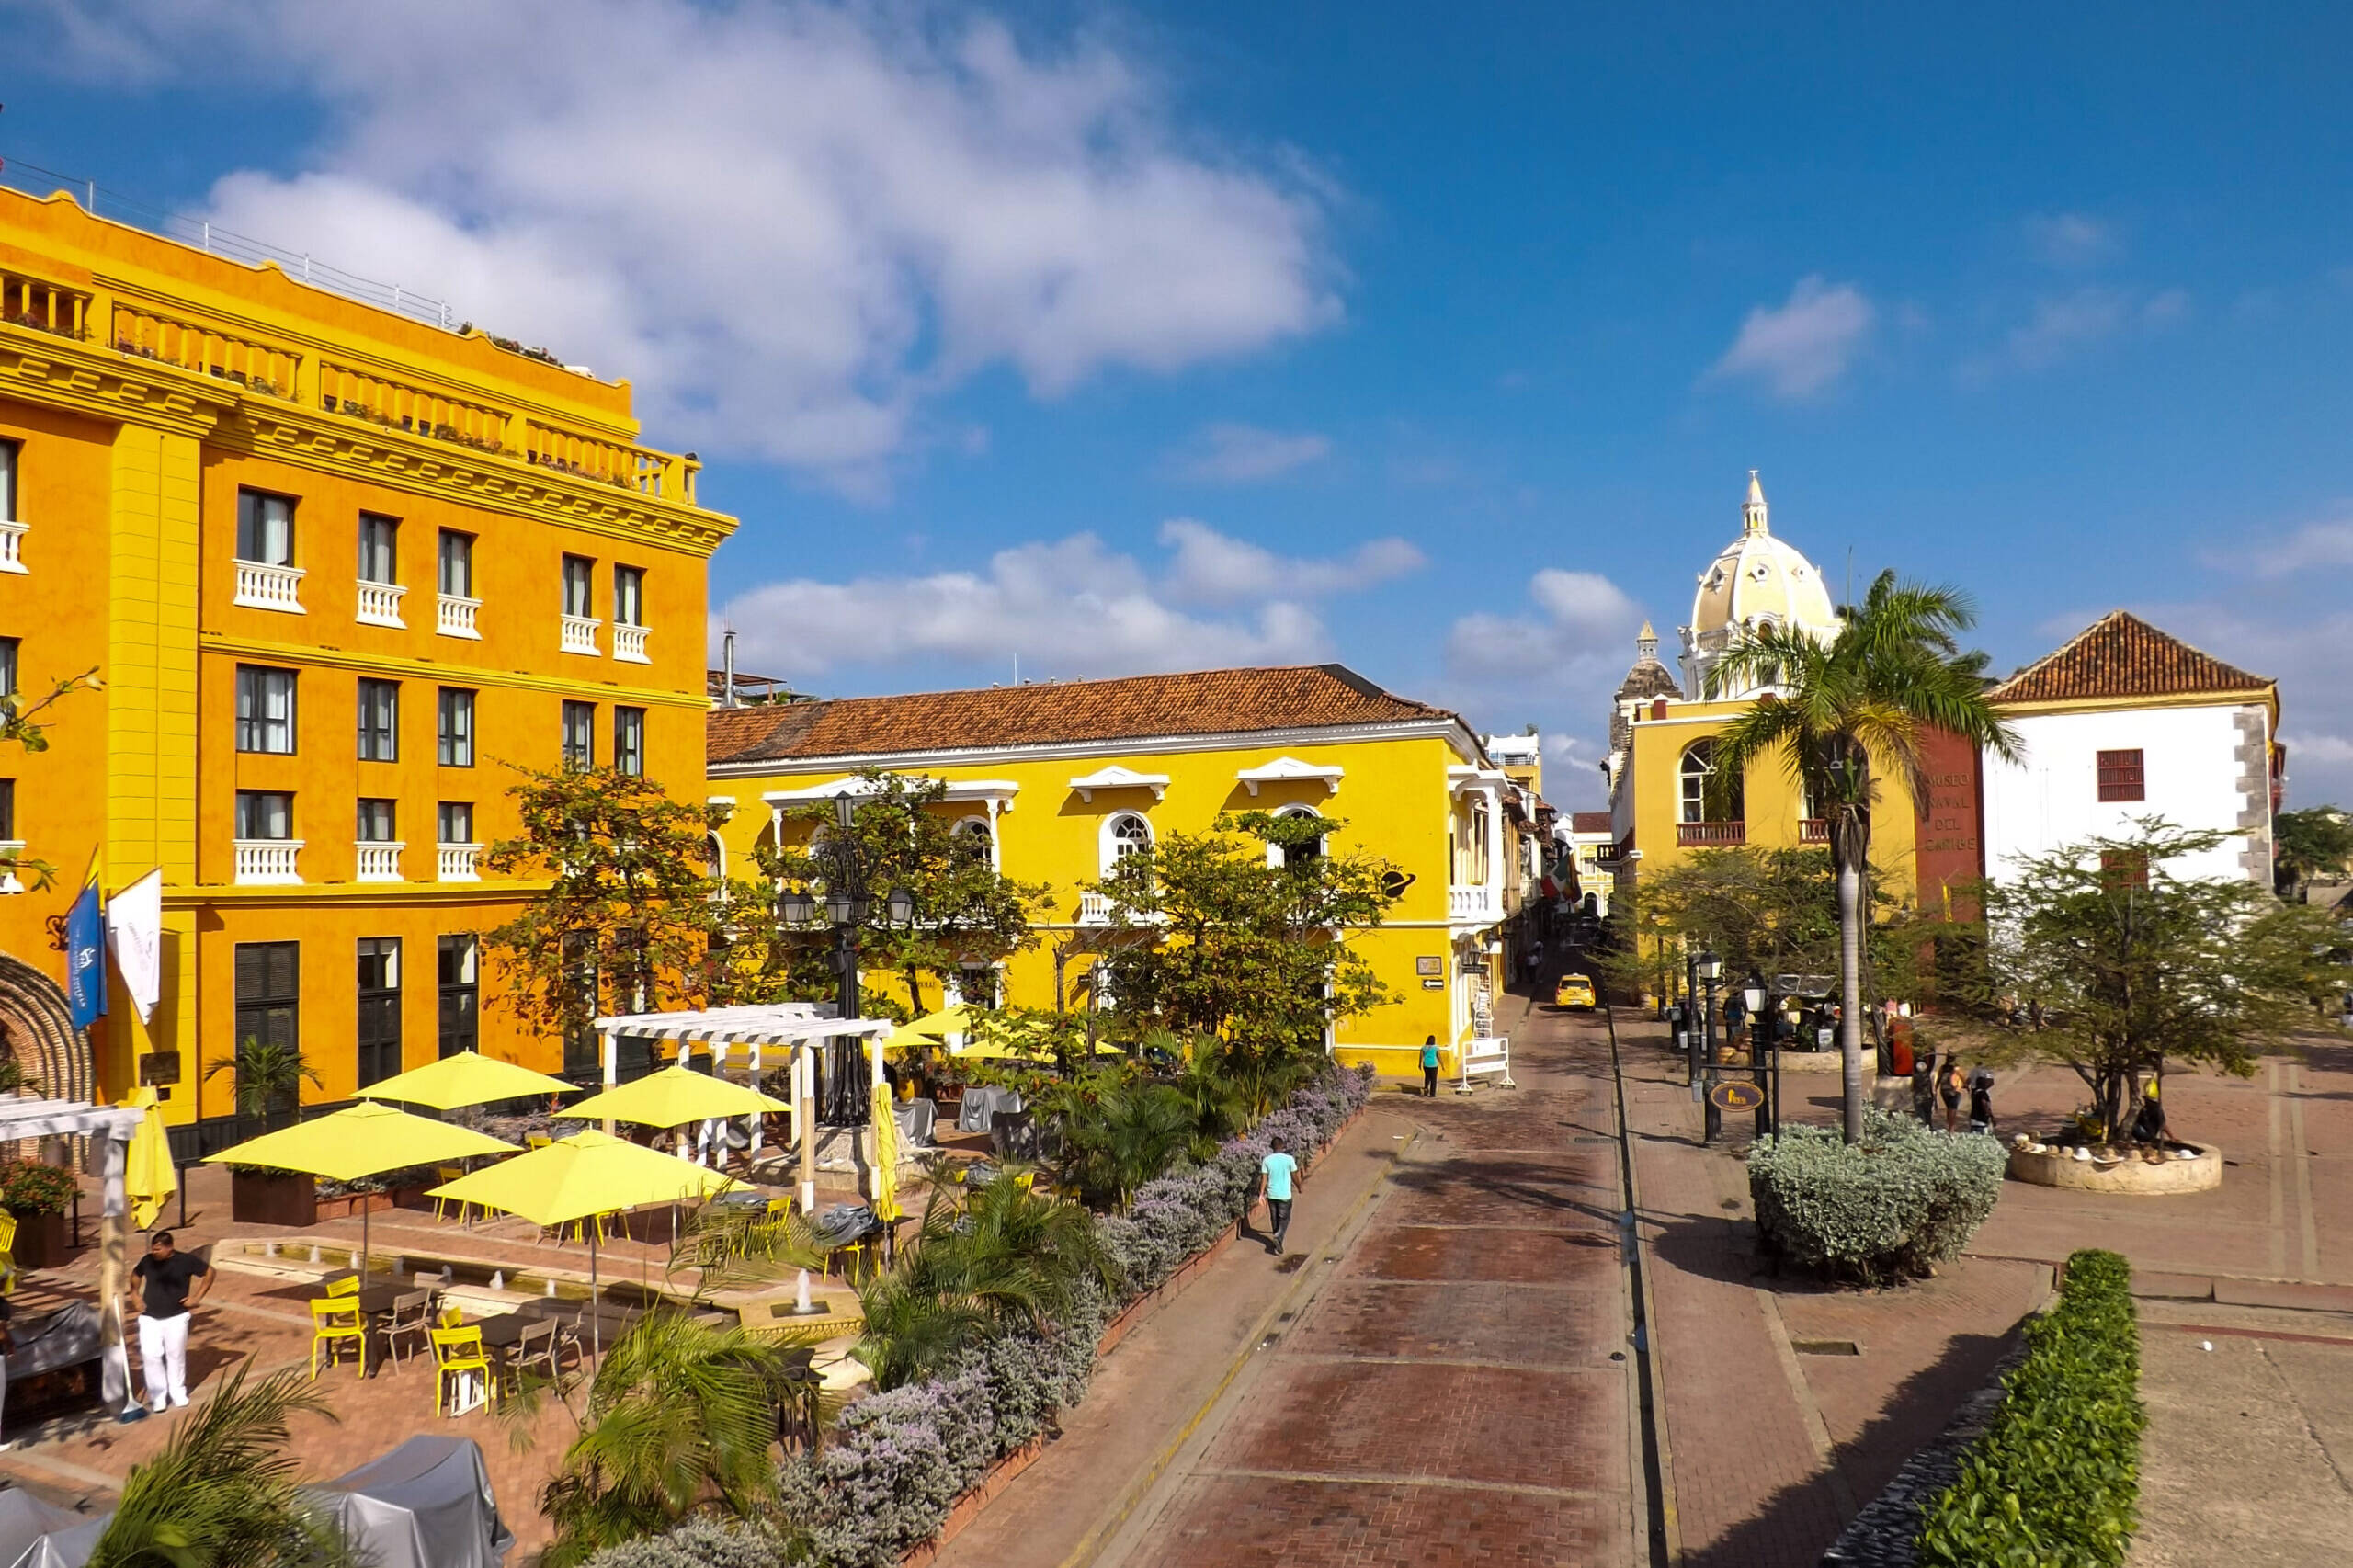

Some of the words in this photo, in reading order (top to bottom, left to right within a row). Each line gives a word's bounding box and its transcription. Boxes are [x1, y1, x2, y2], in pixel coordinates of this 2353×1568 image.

[1927, 773, 1970, 787] MUSEO
[1929, 796, 1971, 809] NAVAL
[1935, 819, 1961, 831] DEL
[1925, 837, 1977, 851] CARIBE
